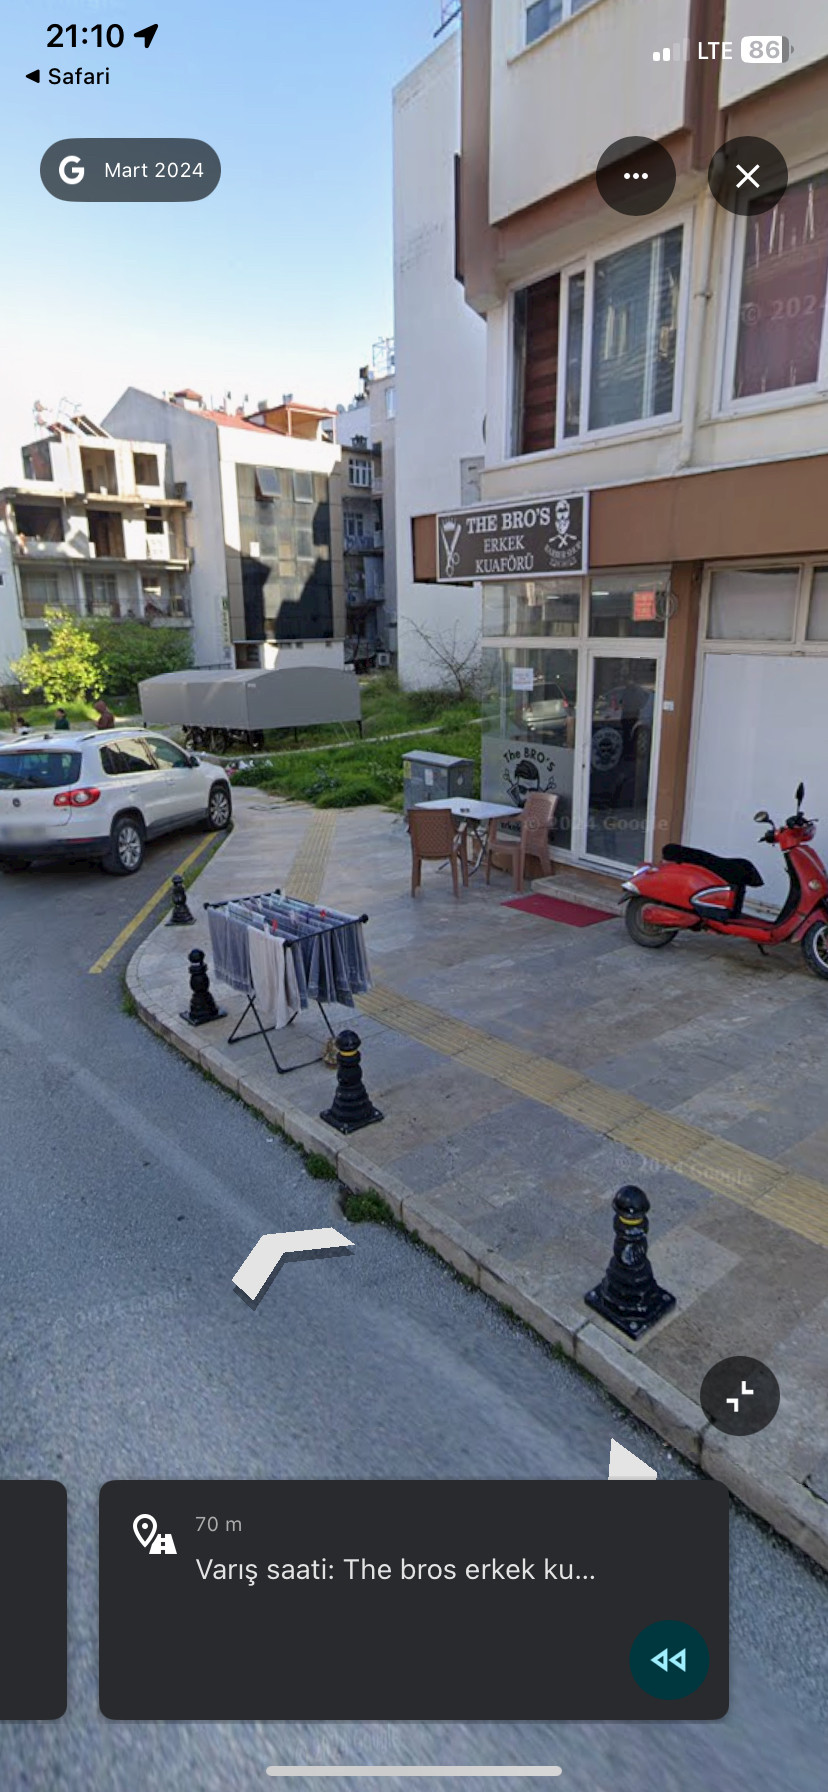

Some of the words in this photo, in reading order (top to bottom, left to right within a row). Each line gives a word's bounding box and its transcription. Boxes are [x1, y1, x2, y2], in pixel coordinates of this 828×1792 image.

[466, 514, 498, 534] THE
[502, 507, 550, 531] BRO'S
[483, 535, 525, 553] ERKEK
[475, 553, 534, 573] KUAFÖRÜ
[503, 749, 521, 763] The
[524, 747, 556, 772] BRO'S
